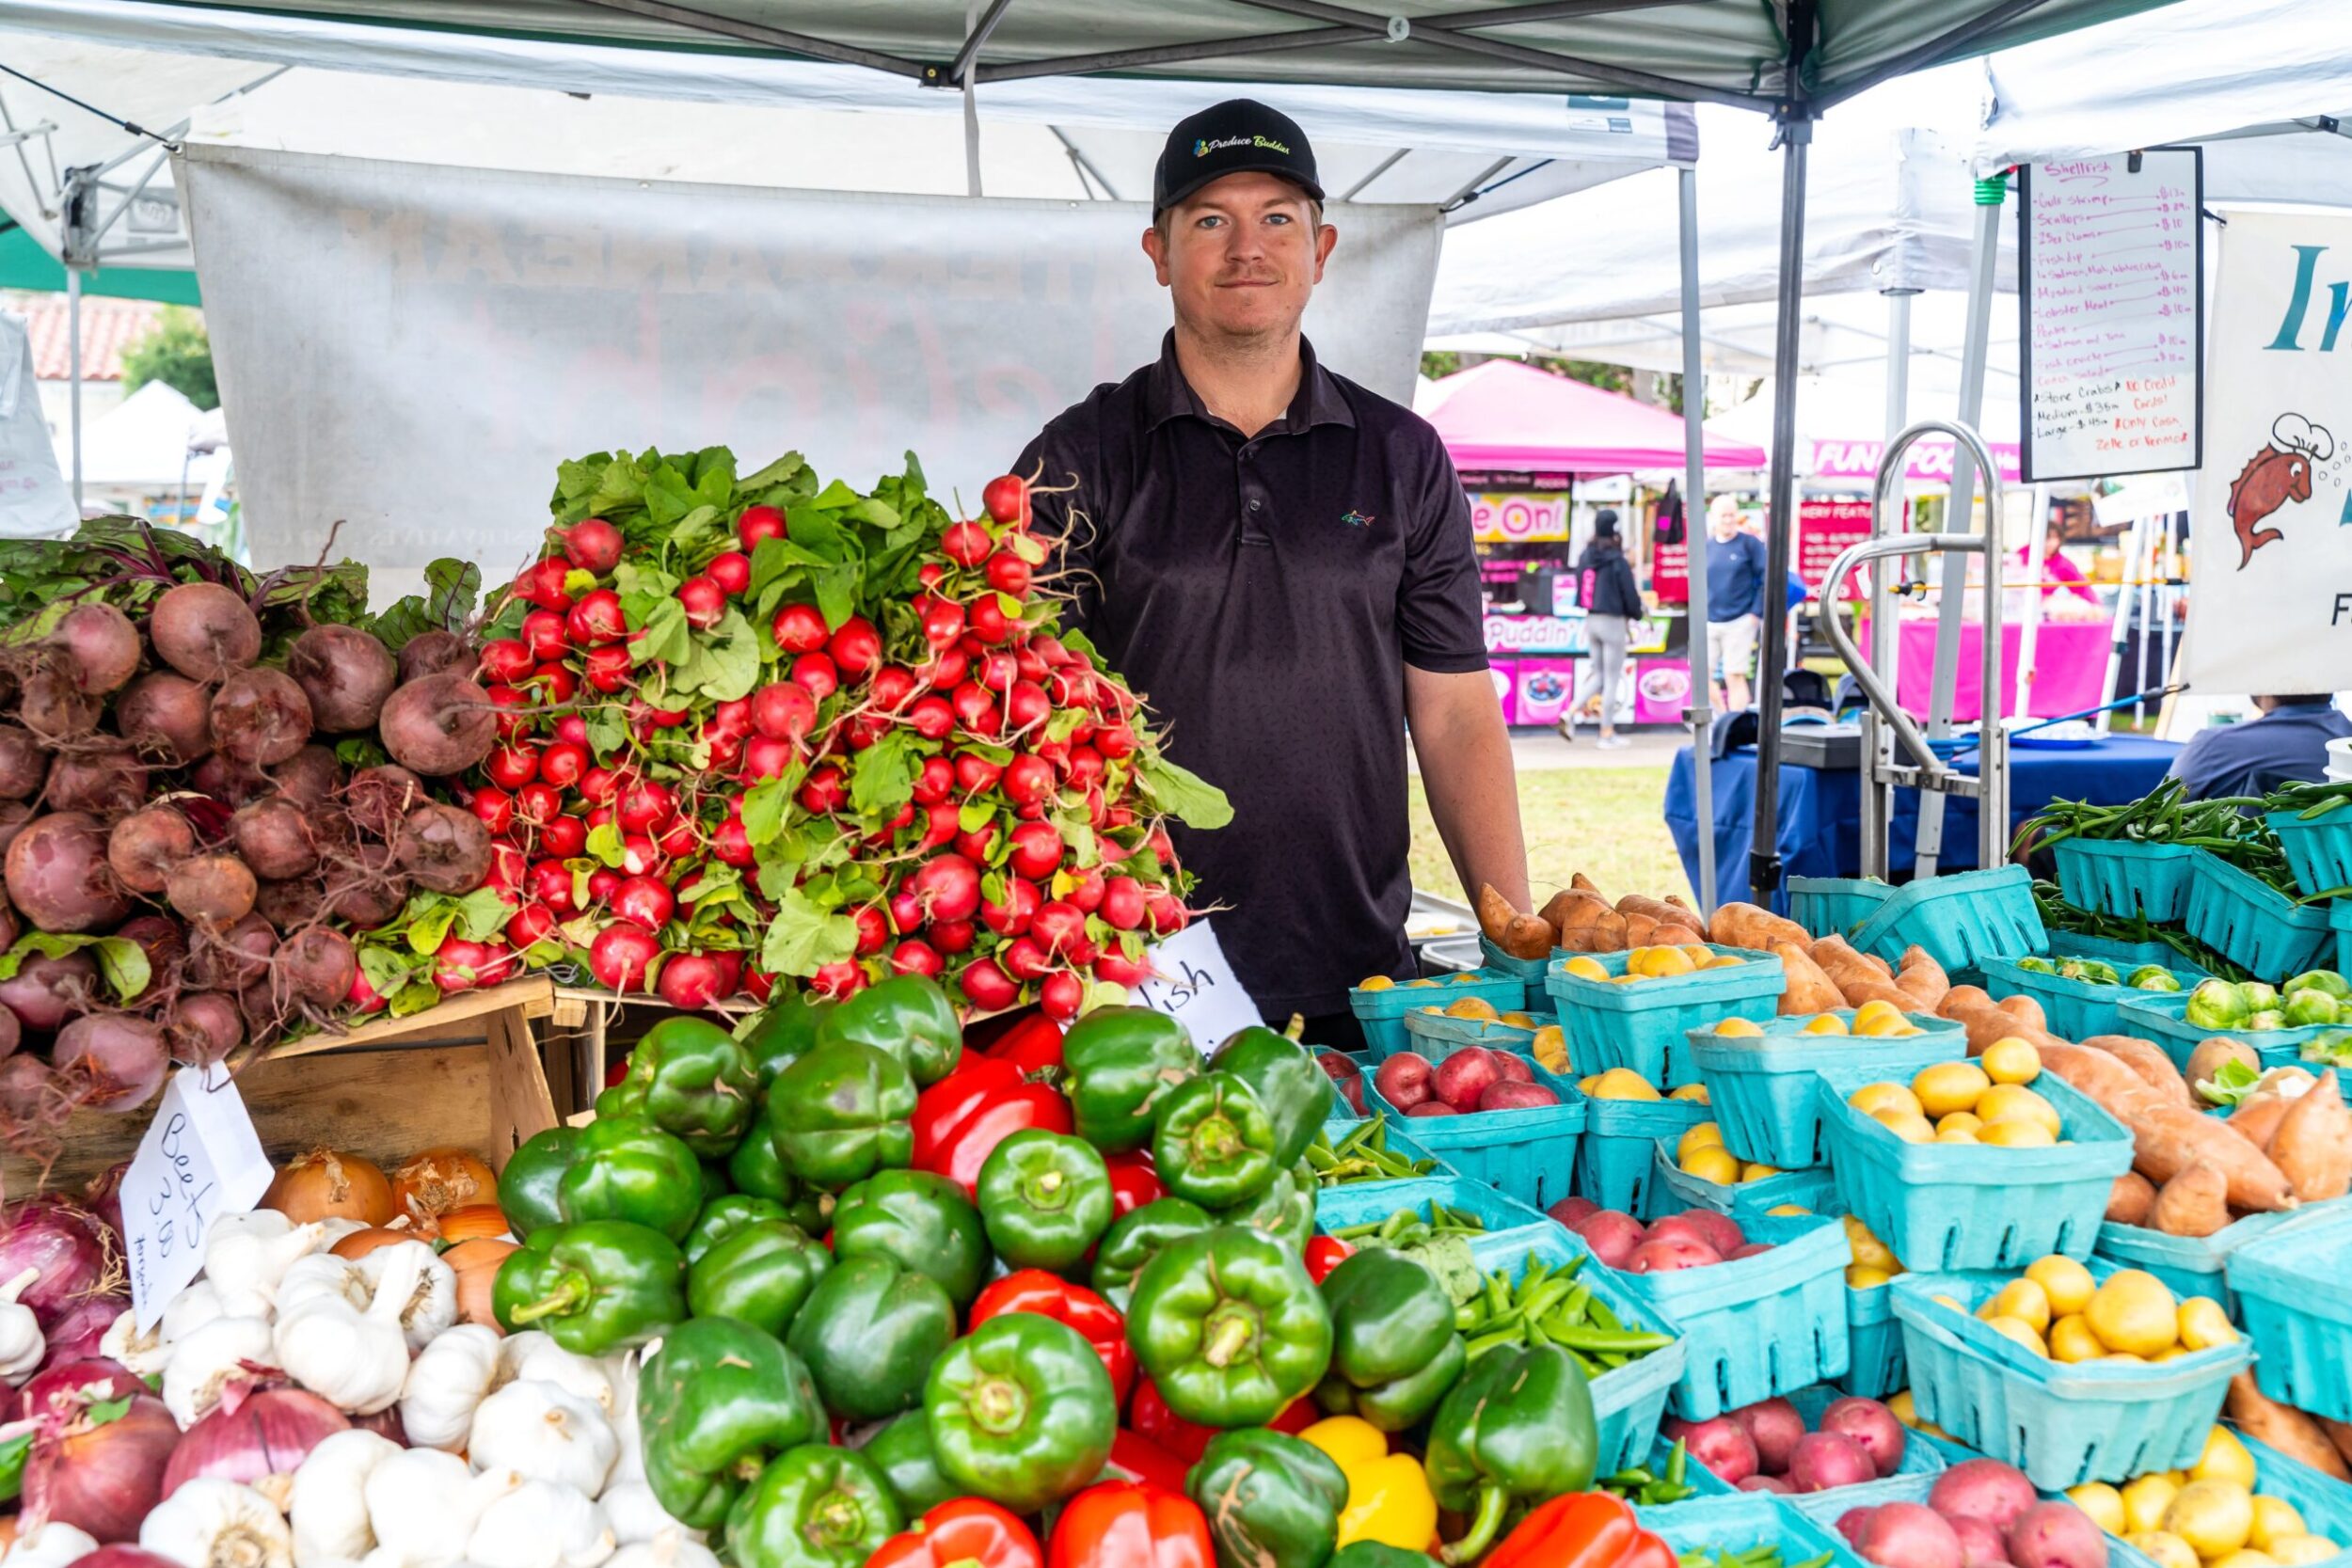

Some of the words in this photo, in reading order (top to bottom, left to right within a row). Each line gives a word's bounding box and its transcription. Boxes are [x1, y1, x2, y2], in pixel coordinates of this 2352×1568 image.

[1208, 135, 1252, 152] Produce
[1253, 135, 1290, 155] Buddies
[1816, 443, 1877, 472] FUN
[162, 1113, 214, 1249] Beets
[150, 1177, 174, 1258] 3.00
